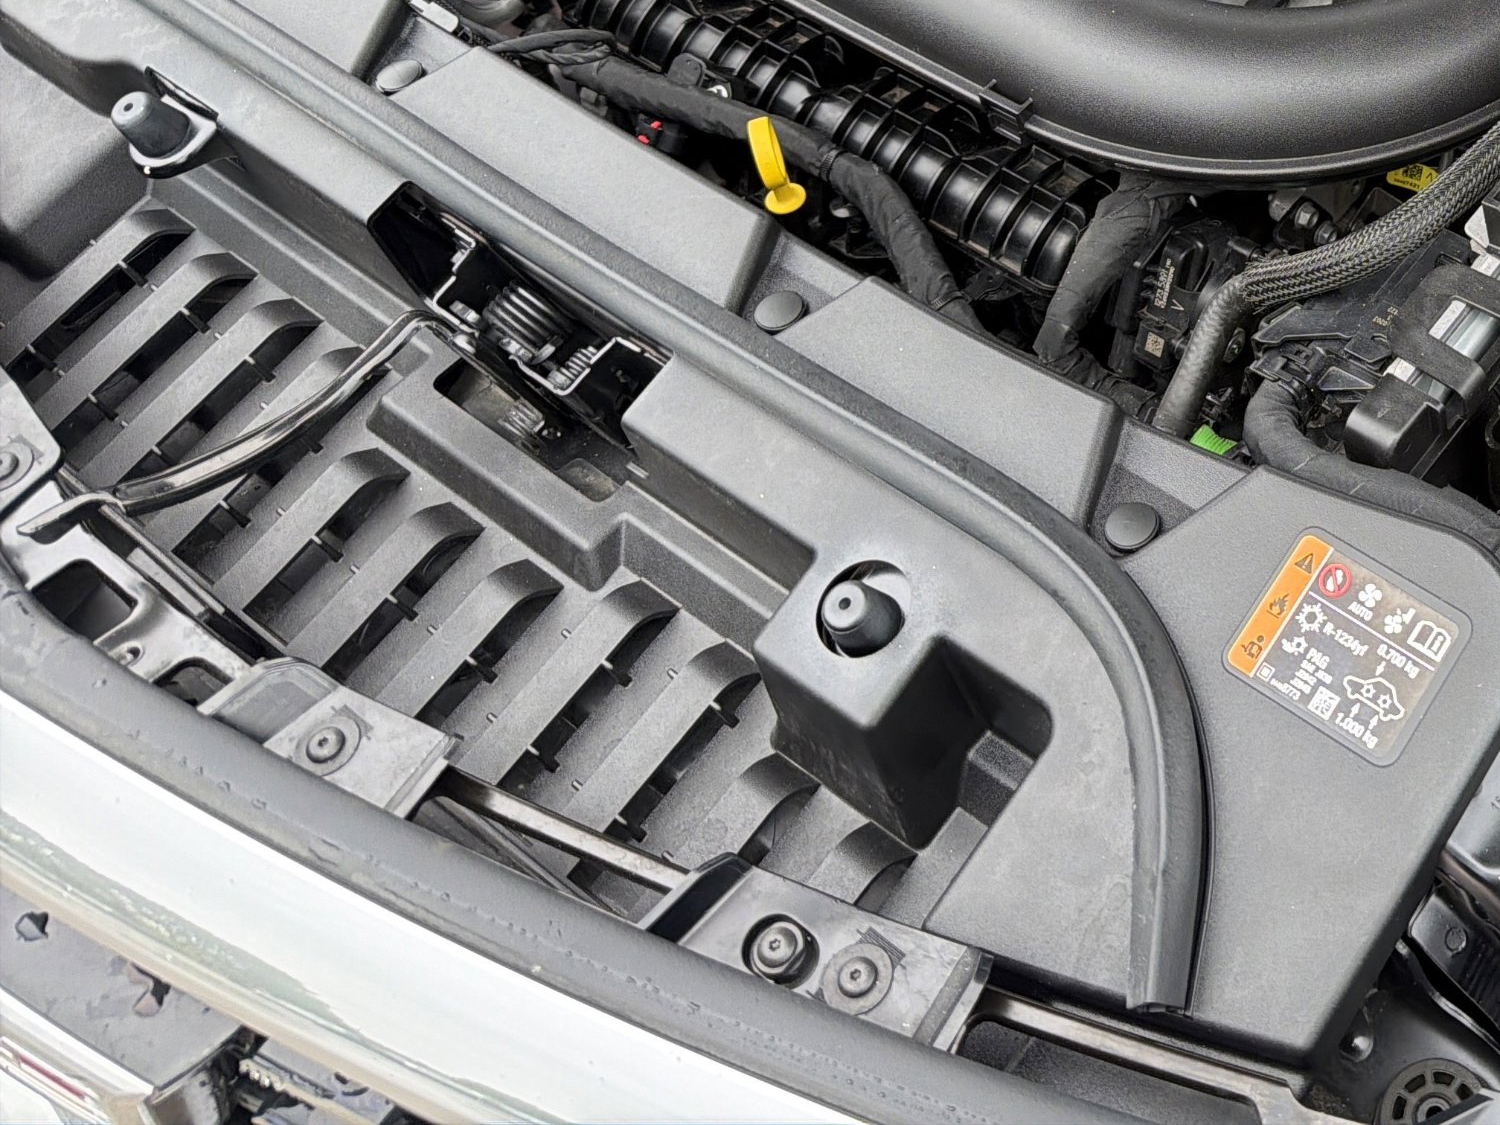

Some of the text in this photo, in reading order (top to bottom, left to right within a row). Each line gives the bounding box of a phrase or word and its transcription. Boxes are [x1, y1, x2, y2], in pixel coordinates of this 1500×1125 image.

[1348, 600, 1372, 621] AUTO
[1321, 621, 1368, 658] R-1234yf
[1305, 647, 1330, 669] PAG
[1376, 643, 1420, 679] 0.700 kg
[1333, 711, 1379, 748] 1.000 kg
